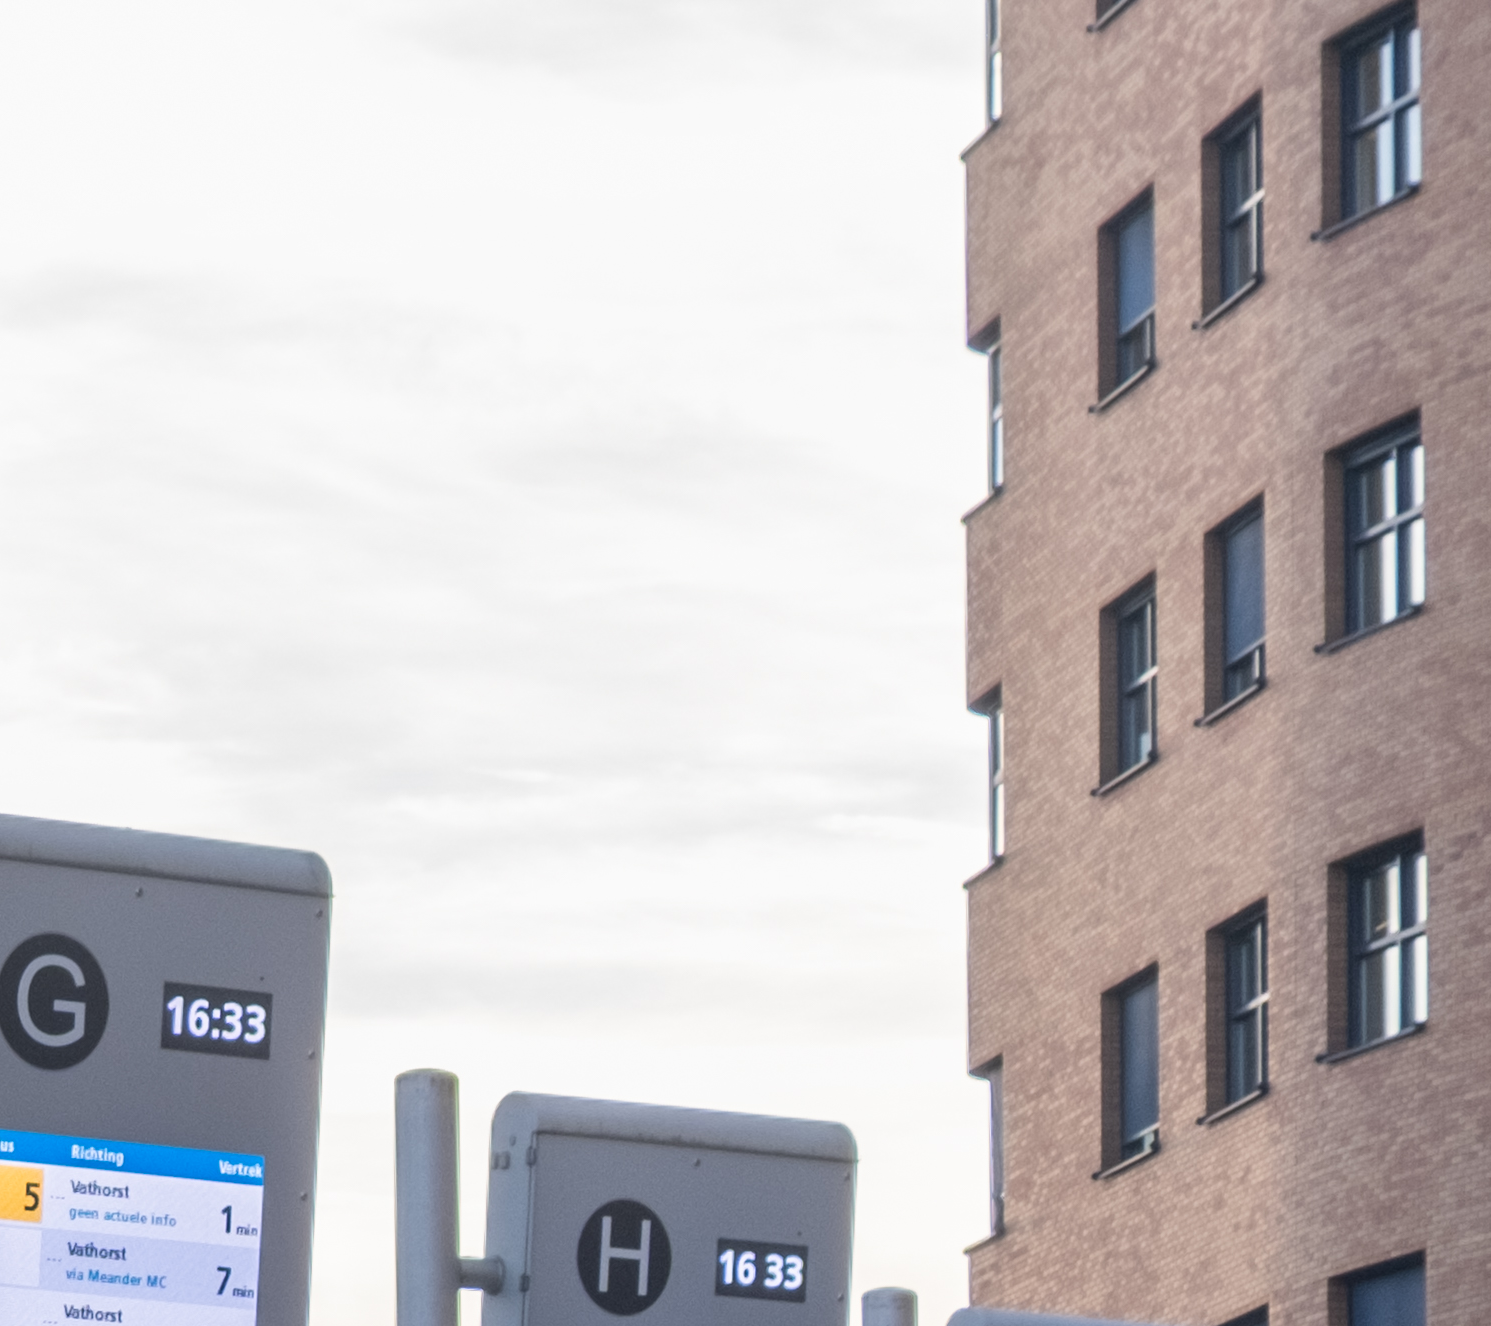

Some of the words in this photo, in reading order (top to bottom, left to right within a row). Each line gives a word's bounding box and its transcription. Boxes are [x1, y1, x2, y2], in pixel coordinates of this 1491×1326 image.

[17, 954, 86, 1047] G
[167, 996, 267, 1044] 16:33
[24, 1183, 40, 1211] 5
[71, 1180, 129, 1198] Vathorst
[221, 1205, 232, 1233] 1
[599, 1216, 651, 1296] H
[216, 1266, 232, 1295] 7
